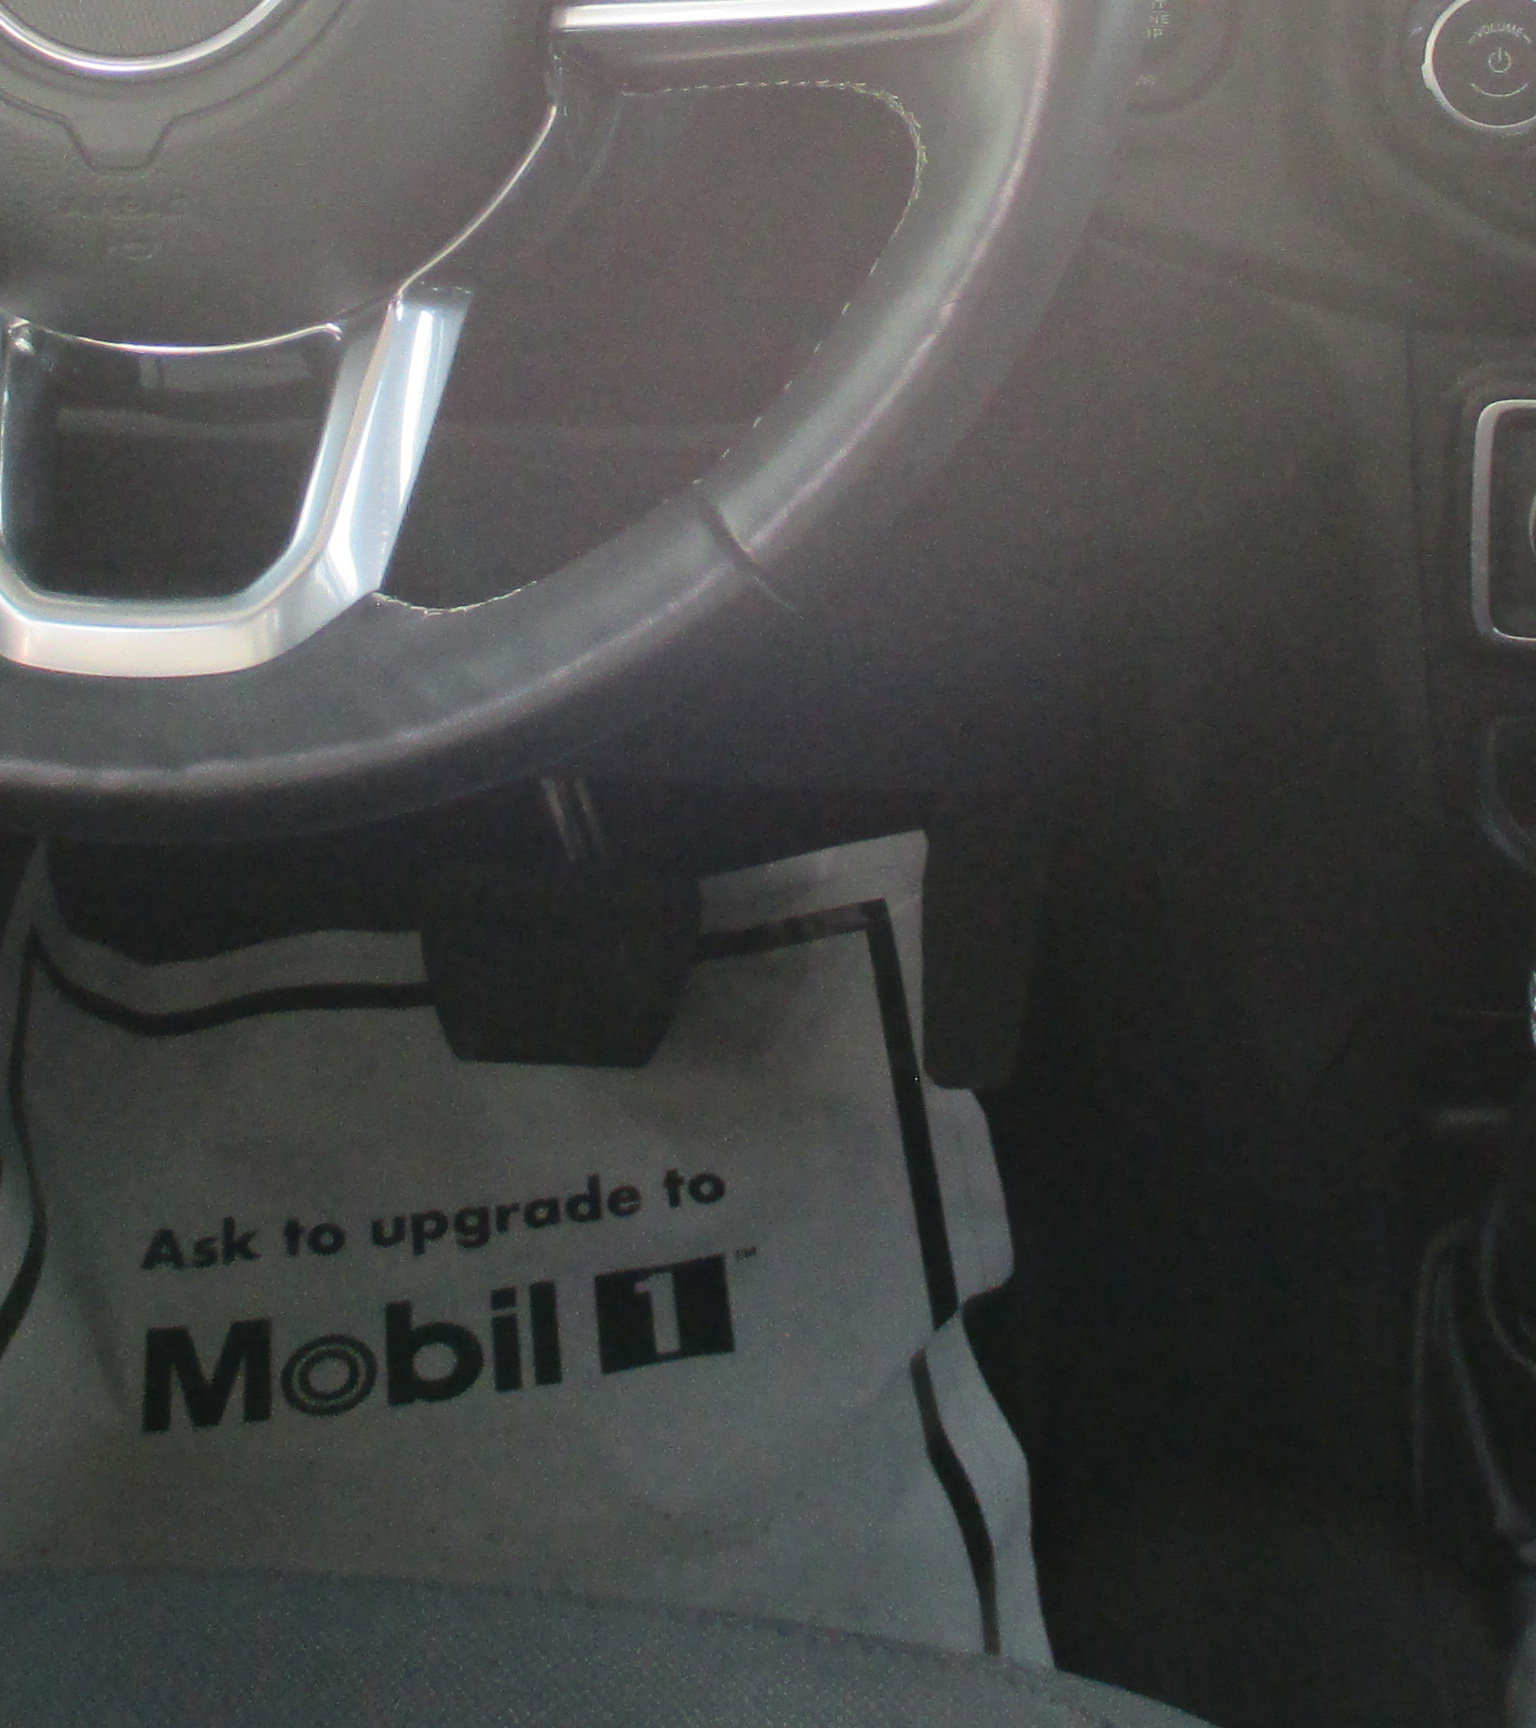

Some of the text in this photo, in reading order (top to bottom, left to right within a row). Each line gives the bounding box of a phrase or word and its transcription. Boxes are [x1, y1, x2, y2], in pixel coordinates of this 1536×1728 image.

[140, 1168, 726, 1271] Ask to upgrade to
[142, 1280, 564, 1434] Mobil
